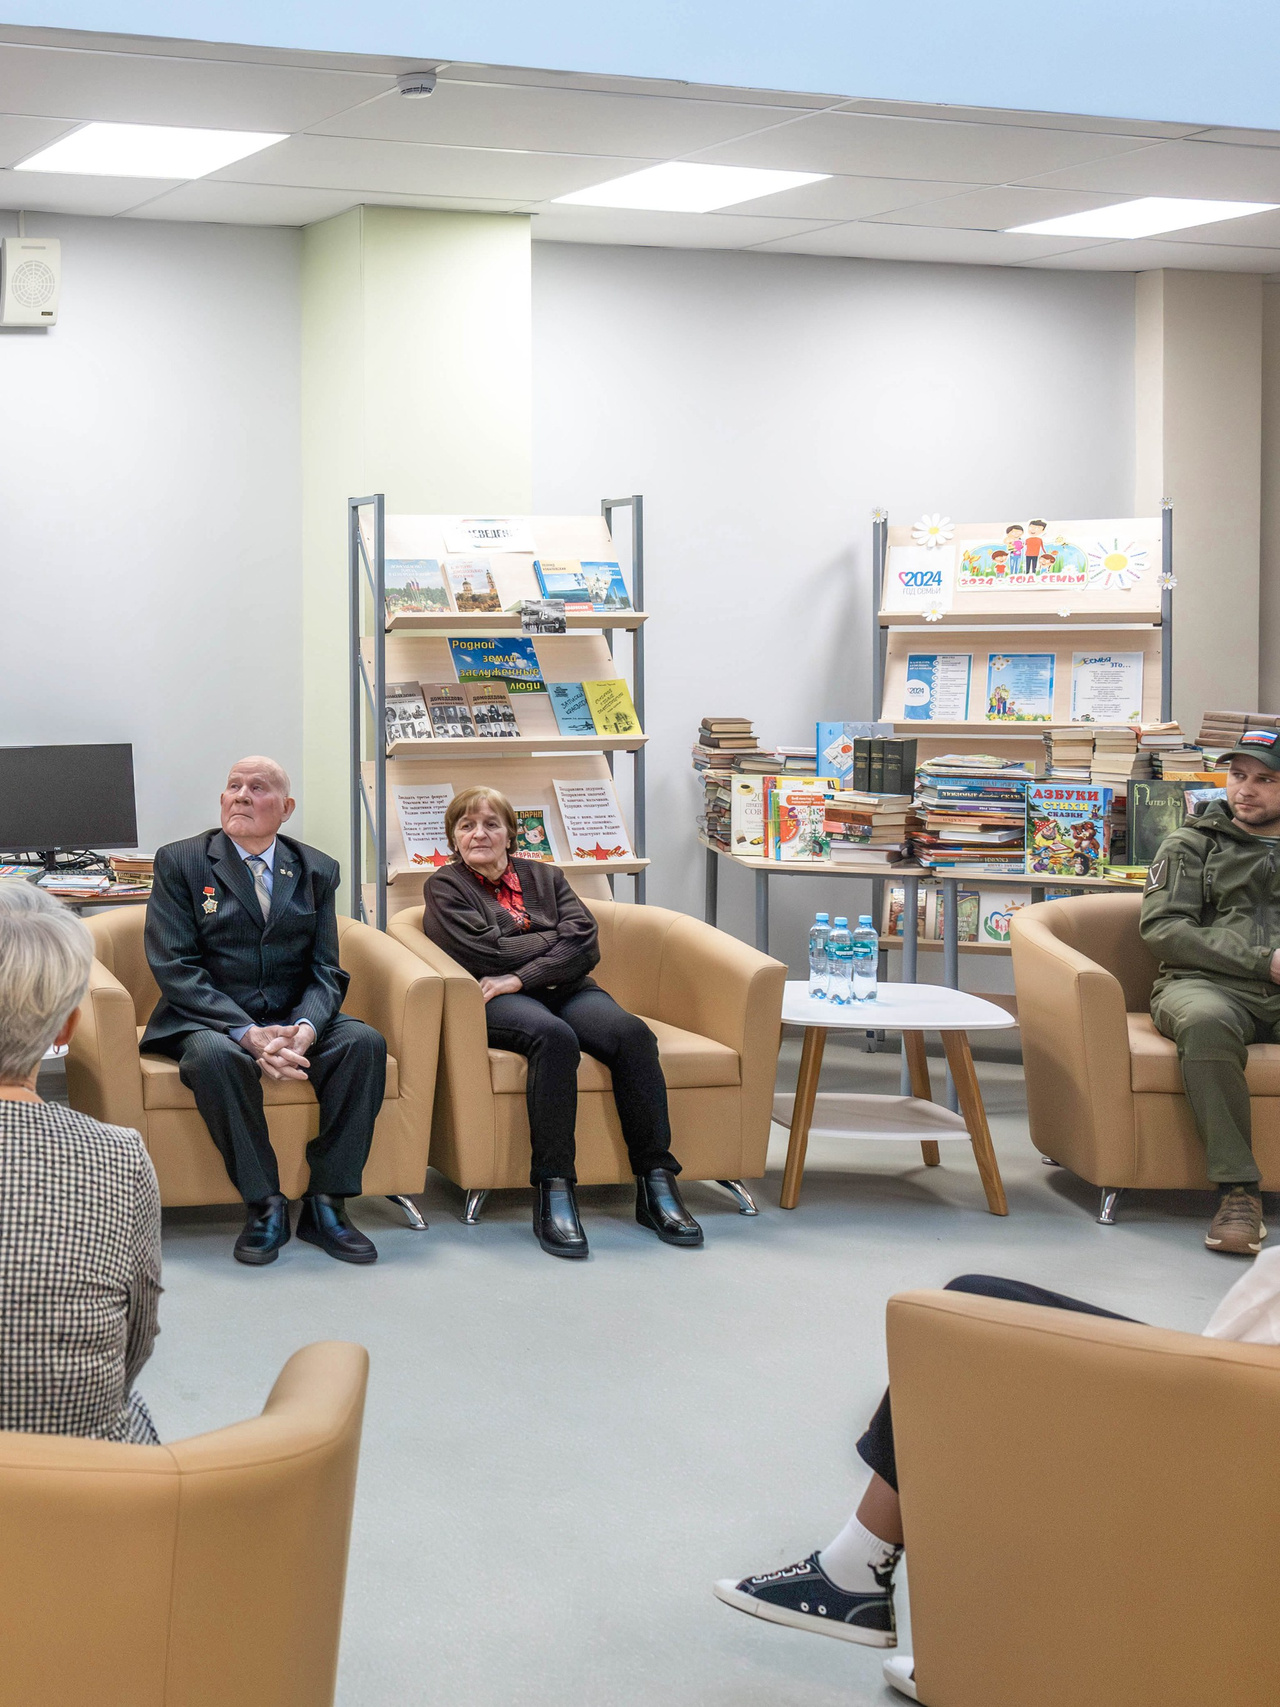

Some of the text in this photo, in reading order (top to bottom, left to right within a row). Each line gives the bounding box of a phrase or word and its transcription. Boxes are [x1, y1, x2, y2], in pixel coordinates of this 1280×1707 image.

[904, 570, 943, 587] 2024
[1009, 575, 1036, 583] ГОД
[1041, 574, 1085, 583] СЕМЬИ
[917, 587, 941, 595] СЕМЬИ
[452, 640, 495, 650] Родной
[460, 667, 540, 678] заслуженные
[510, 682, 541, 691] люди
[1033, 788, 1099, 801] АЗБУКИ
[1042, 801, 1089, 811] СТИХИ
